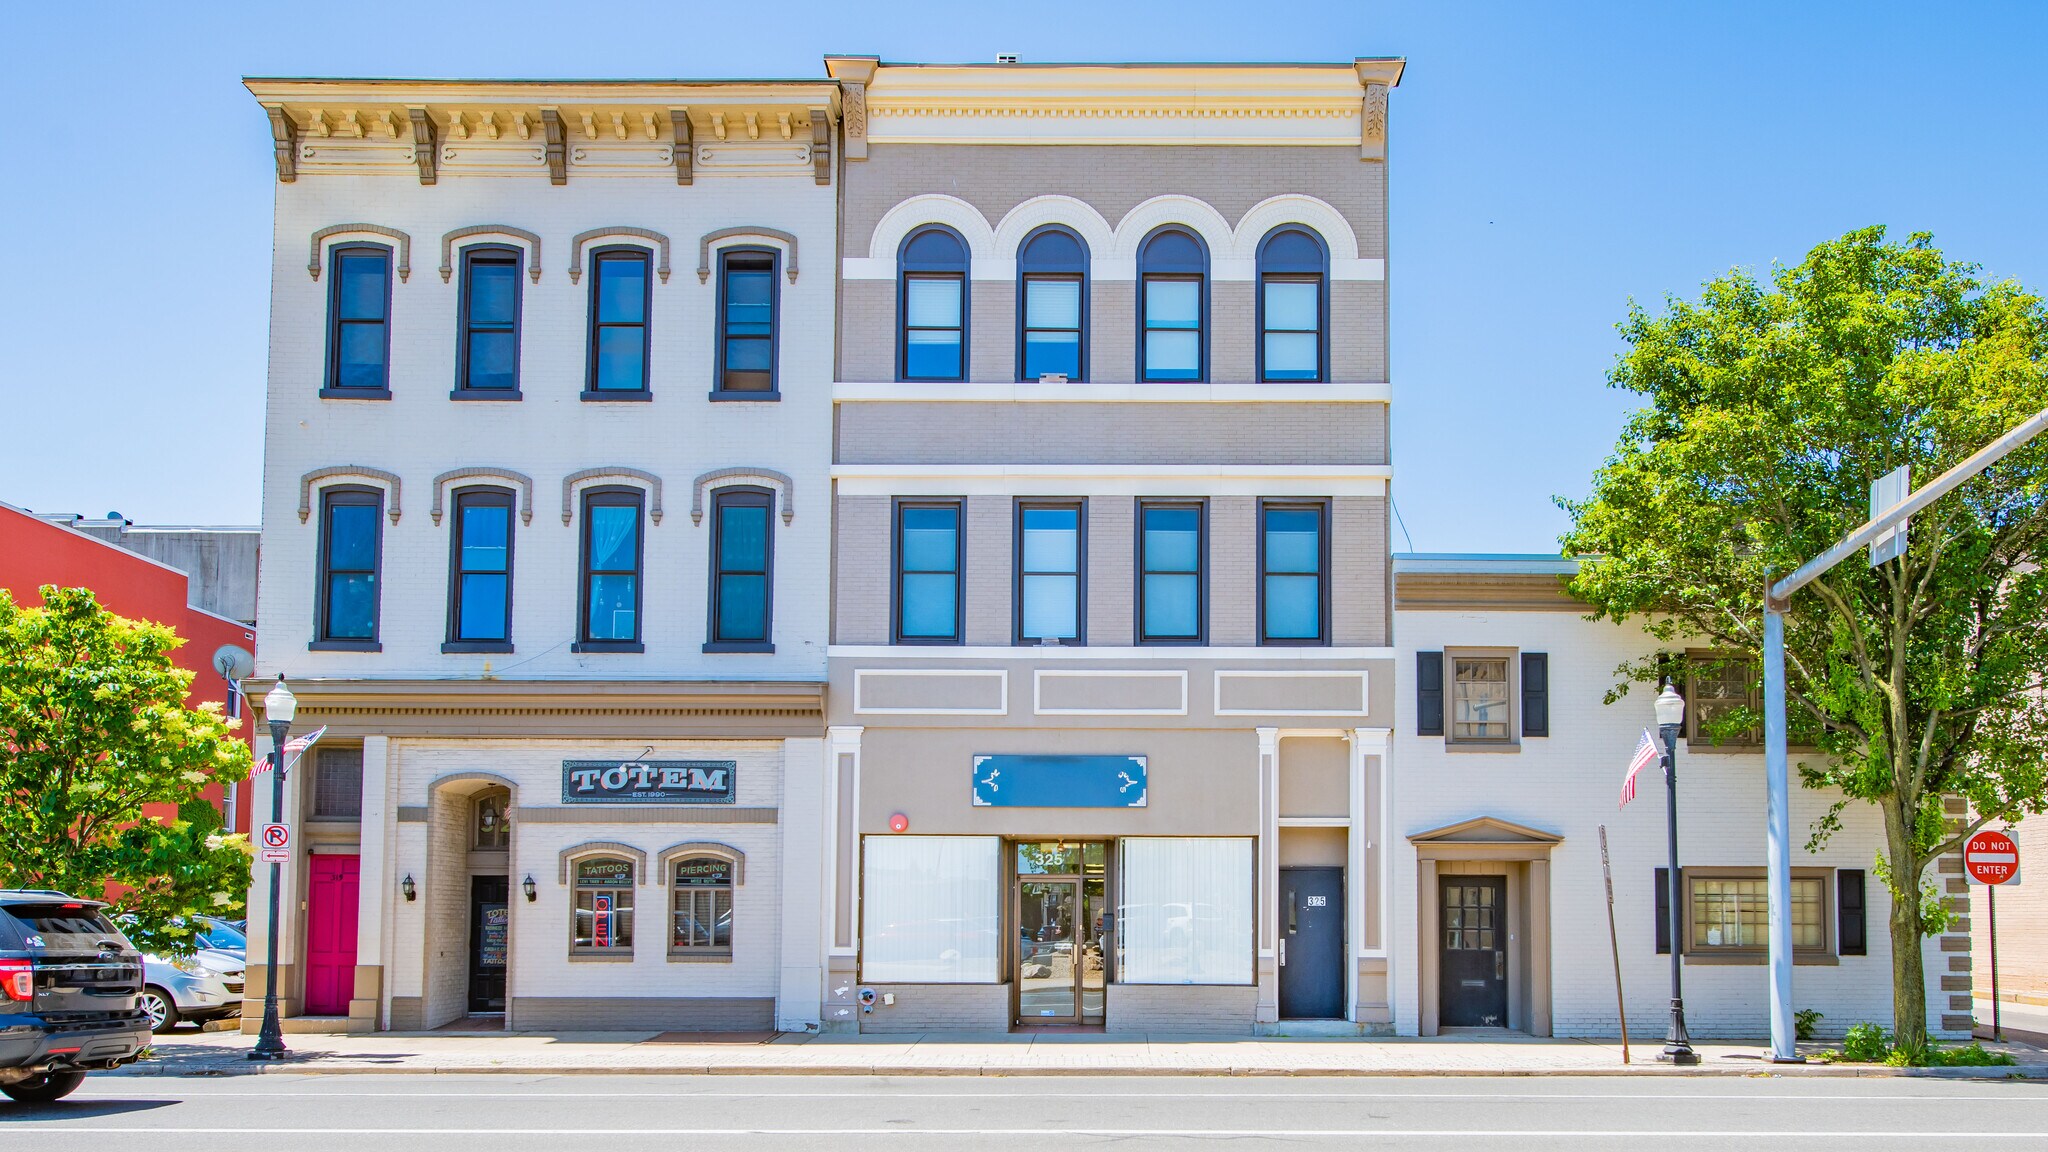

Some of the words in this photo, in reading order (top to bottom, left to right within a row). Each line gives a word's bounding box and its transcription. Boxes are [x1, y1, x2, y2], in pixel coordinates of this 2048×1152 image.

[571, 767, 728, 791] TOTEM
[1972, 841, 1986, 850] DO
[1991, 841, 2011, 850] NOT
[1035, 853, 1063, 866] 325
[584, 864, 629, 875] TATTOOS
[680, 864, 727, 875] PIERCING
[1977, 865, 2008, 874] ENTER
[486, 908, 508, 917] TOTE
[595, 899, 608, 948] OPEN
